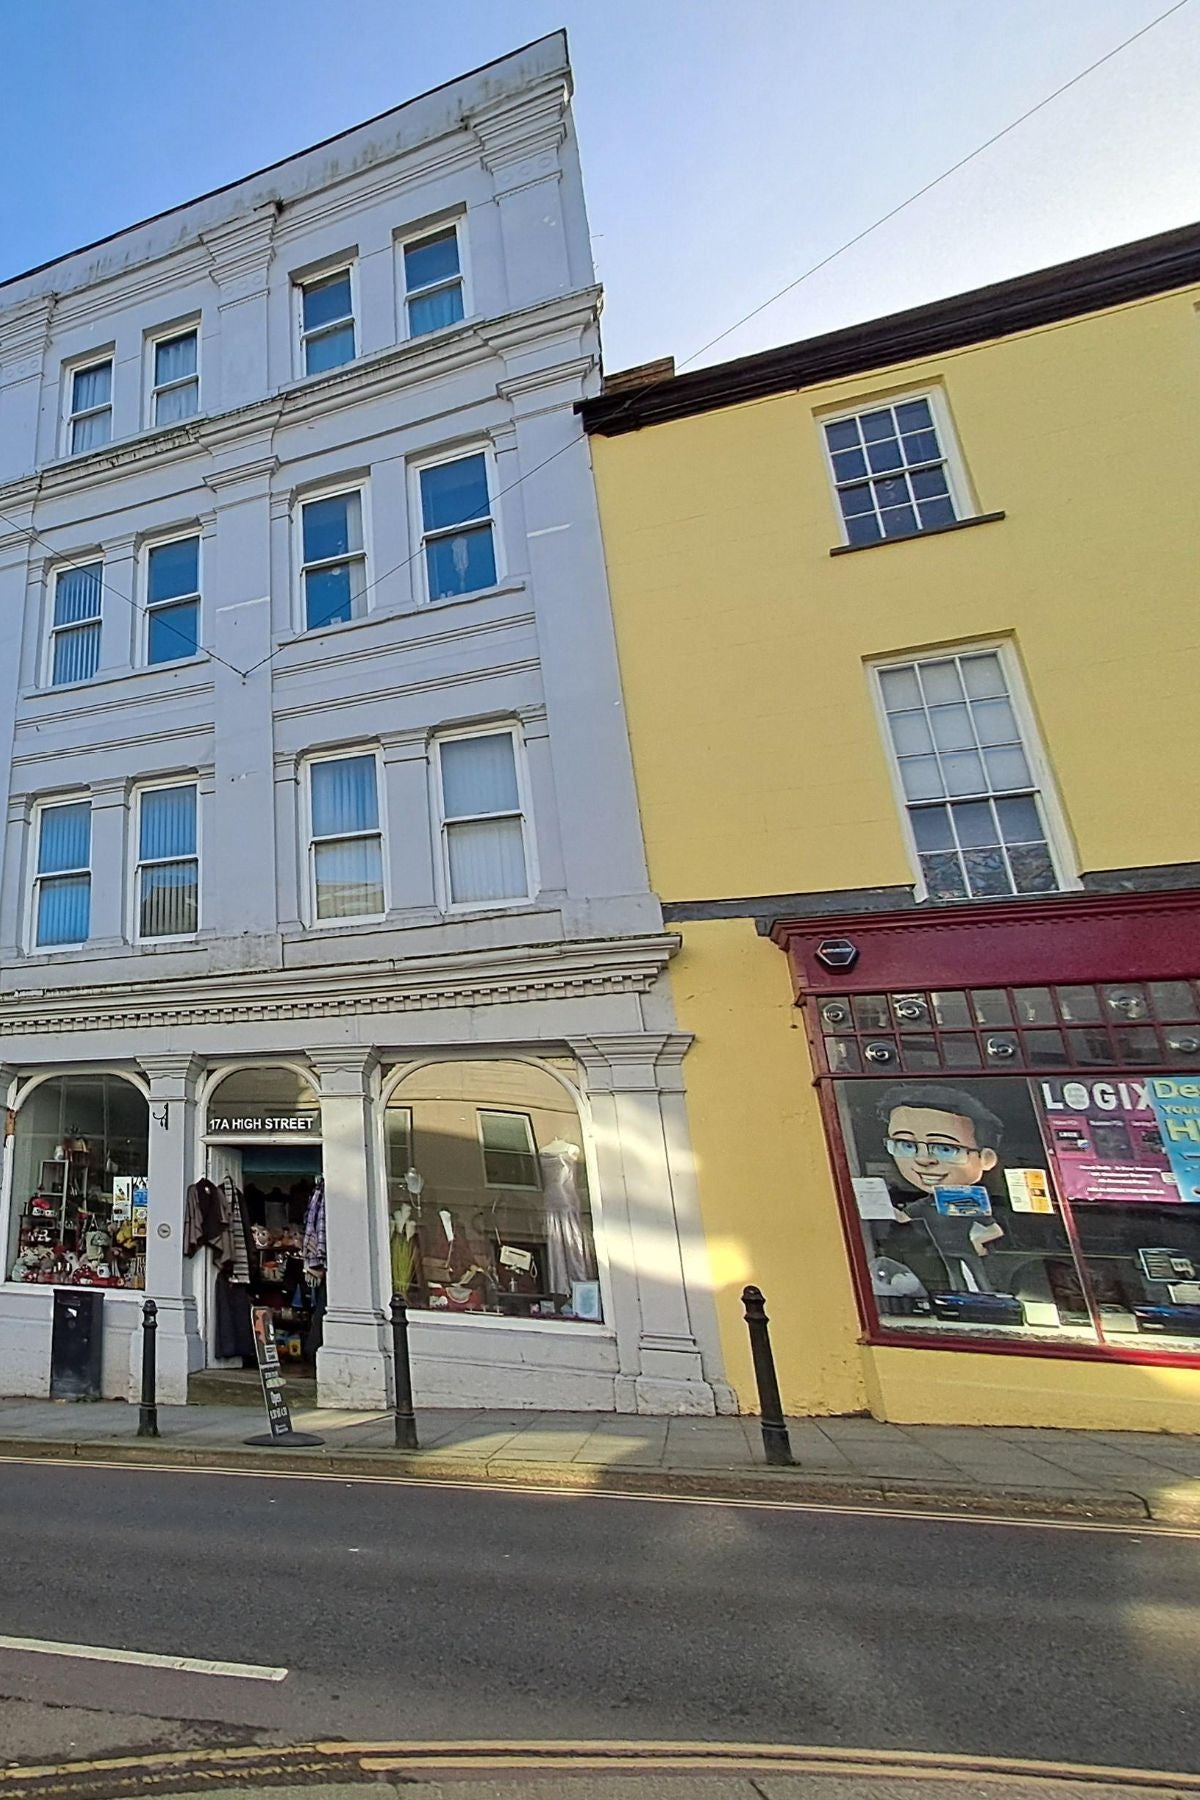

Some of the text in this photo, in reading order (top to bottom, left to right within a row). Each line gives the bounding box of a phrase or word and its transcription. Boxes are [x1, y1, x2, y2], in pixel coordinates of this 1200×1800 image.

[1153, 1081, 1200, 1098] De
[209, 1118, 313, 1129] 17A HIGH STREET
[1166, 1119, 1200, 1141] H
